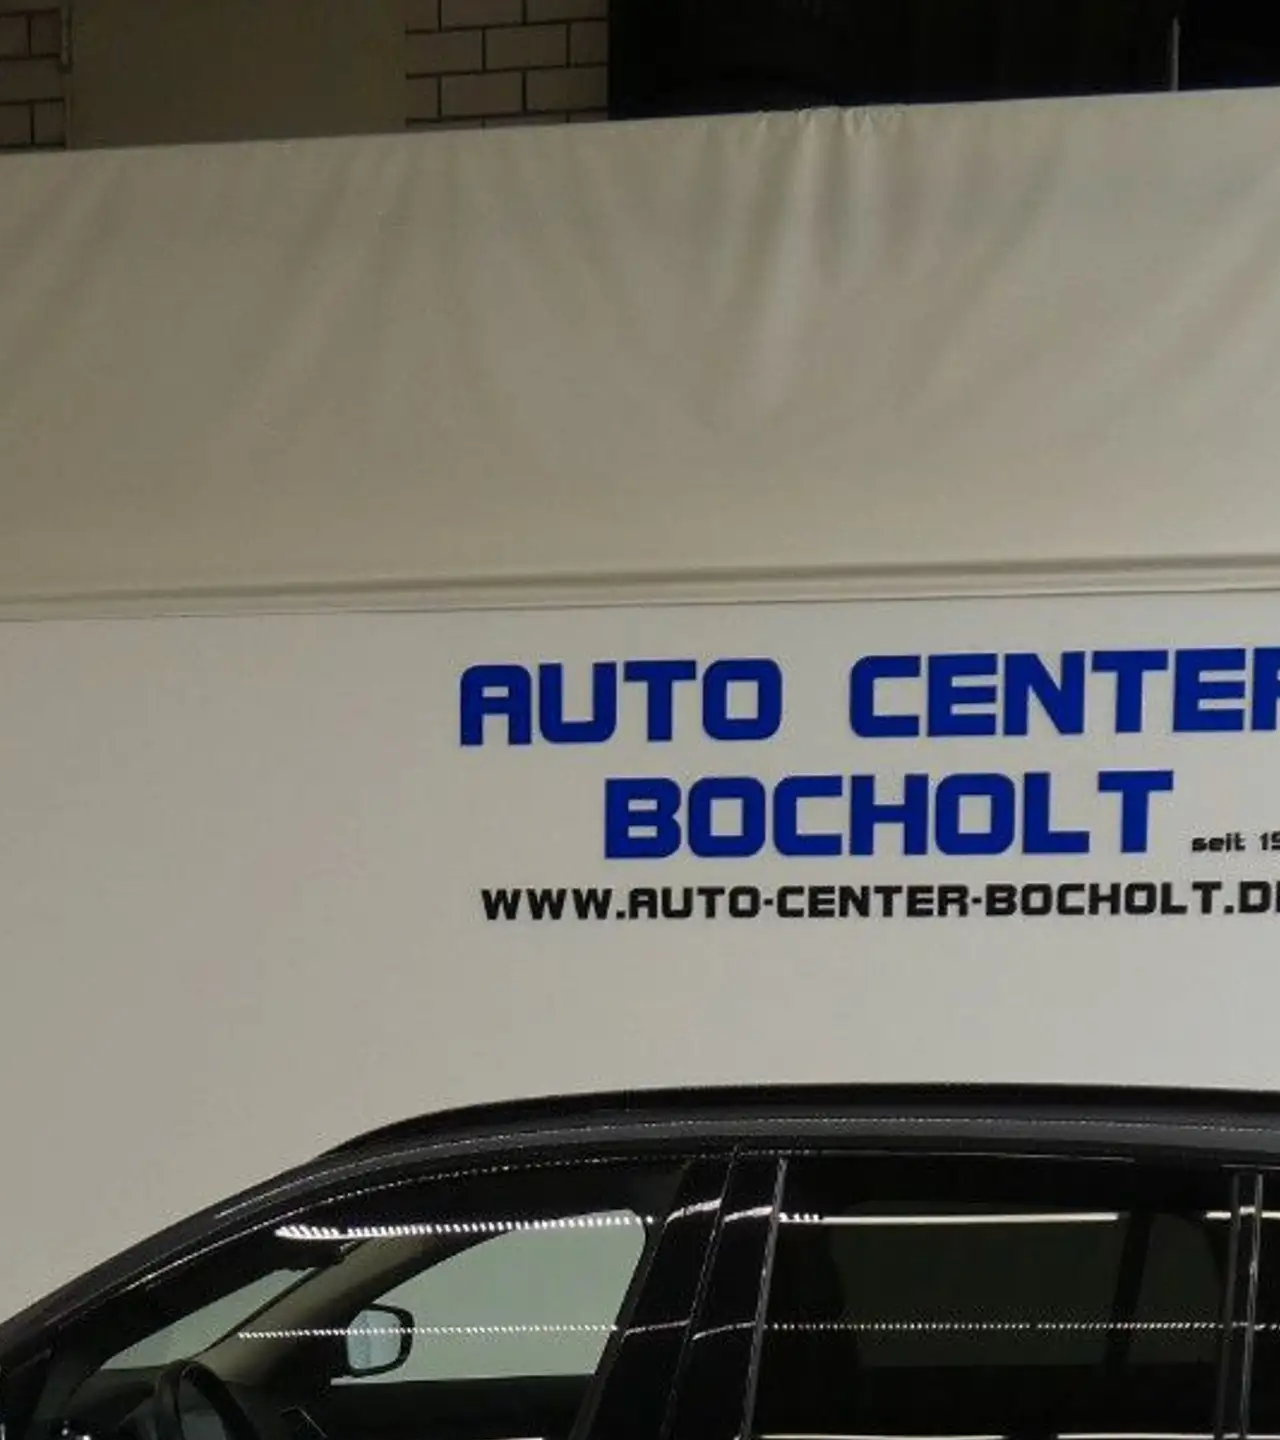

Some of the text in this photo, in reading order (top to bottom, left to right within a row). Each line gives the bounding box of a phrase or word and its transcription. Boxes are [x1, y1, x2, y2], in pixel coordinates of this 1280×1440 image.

[460, 658, 783, 747] AUTO
[604, 770, 1174, 860] BOCHOLT
[1190, 831, 1246, 854] seit
